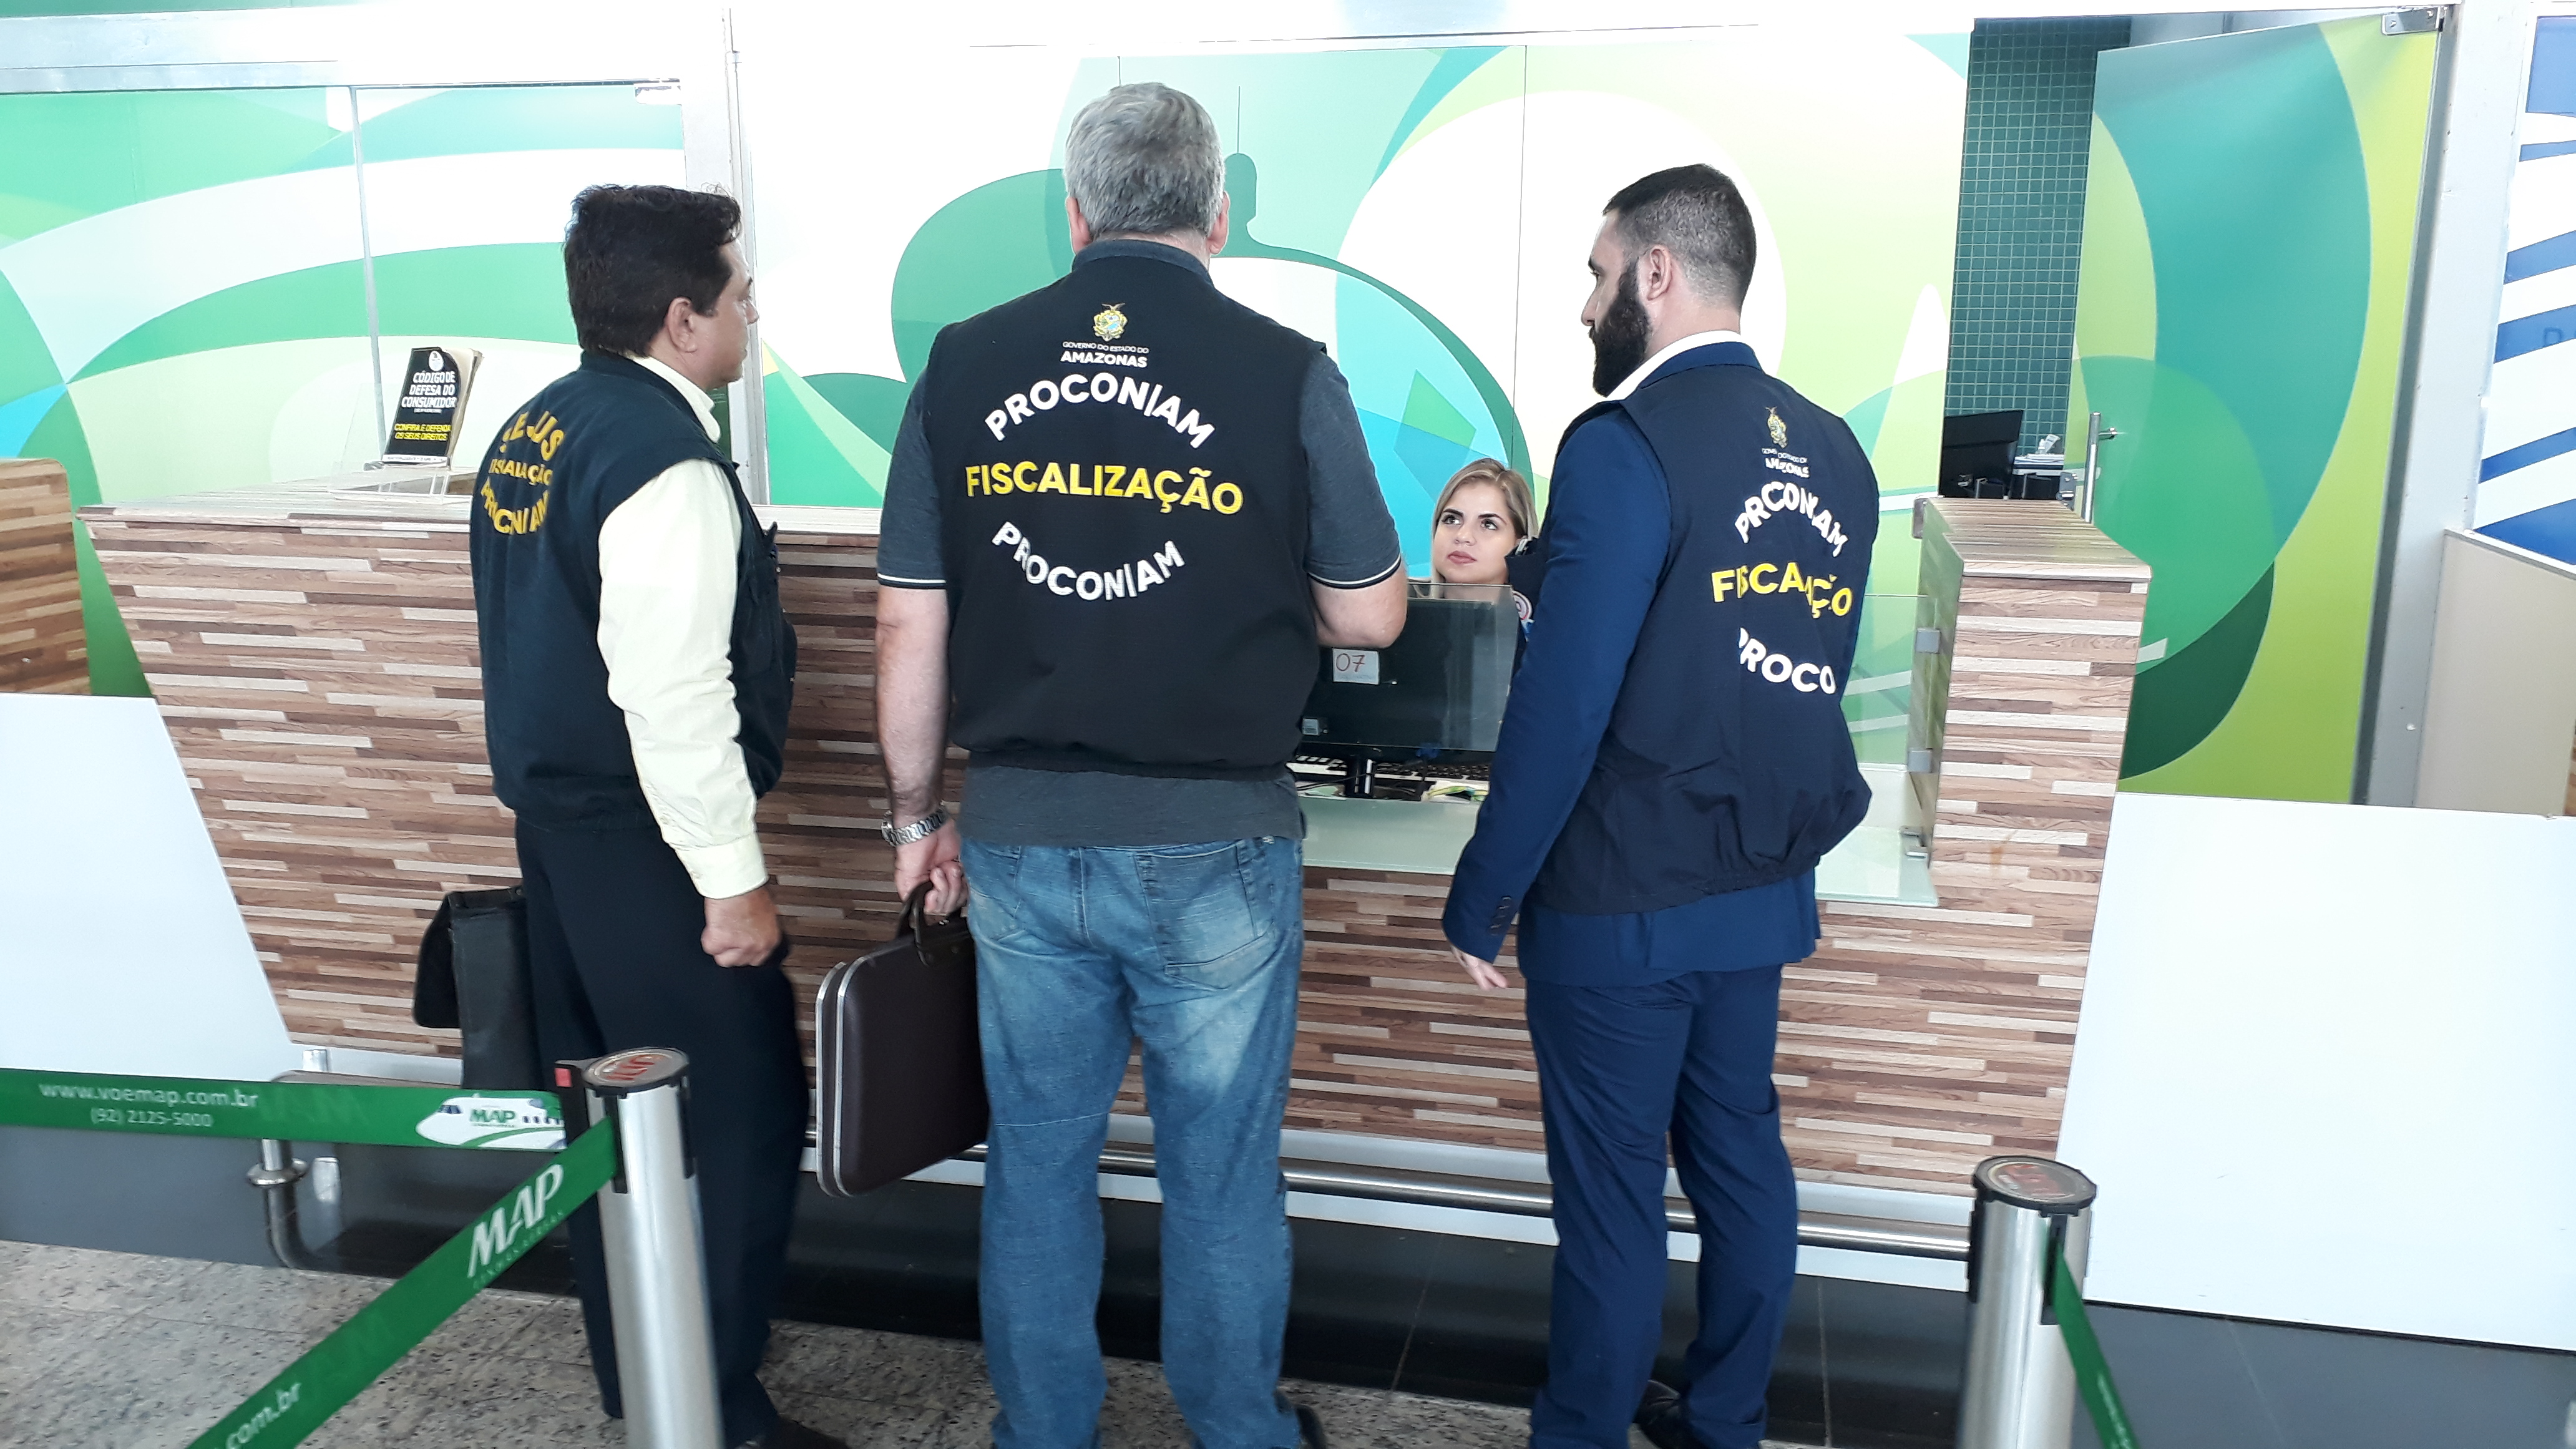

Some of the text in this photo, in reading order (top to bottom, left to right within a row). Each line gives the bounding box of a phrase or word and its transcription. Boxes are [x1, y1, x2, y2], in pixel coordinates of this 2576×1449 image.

[1060, 351, 1148, 368] AMAZONAS
[412, 370, 456, 383] CÓDIGO DE
[409, 384, 456, 396] DEFESA DO
[401, 397, 457, 408] CONSUMIDOR
[965, 461, 1244, 515] FISCALIZAÇÃO
[1335, 653, 1366, 673] 07
[38, 1083, 260, 1108] www.voemap.com.br
[470, 1109, 517, 1123] MAP
[467, 1164, 565, 1278] MAP
